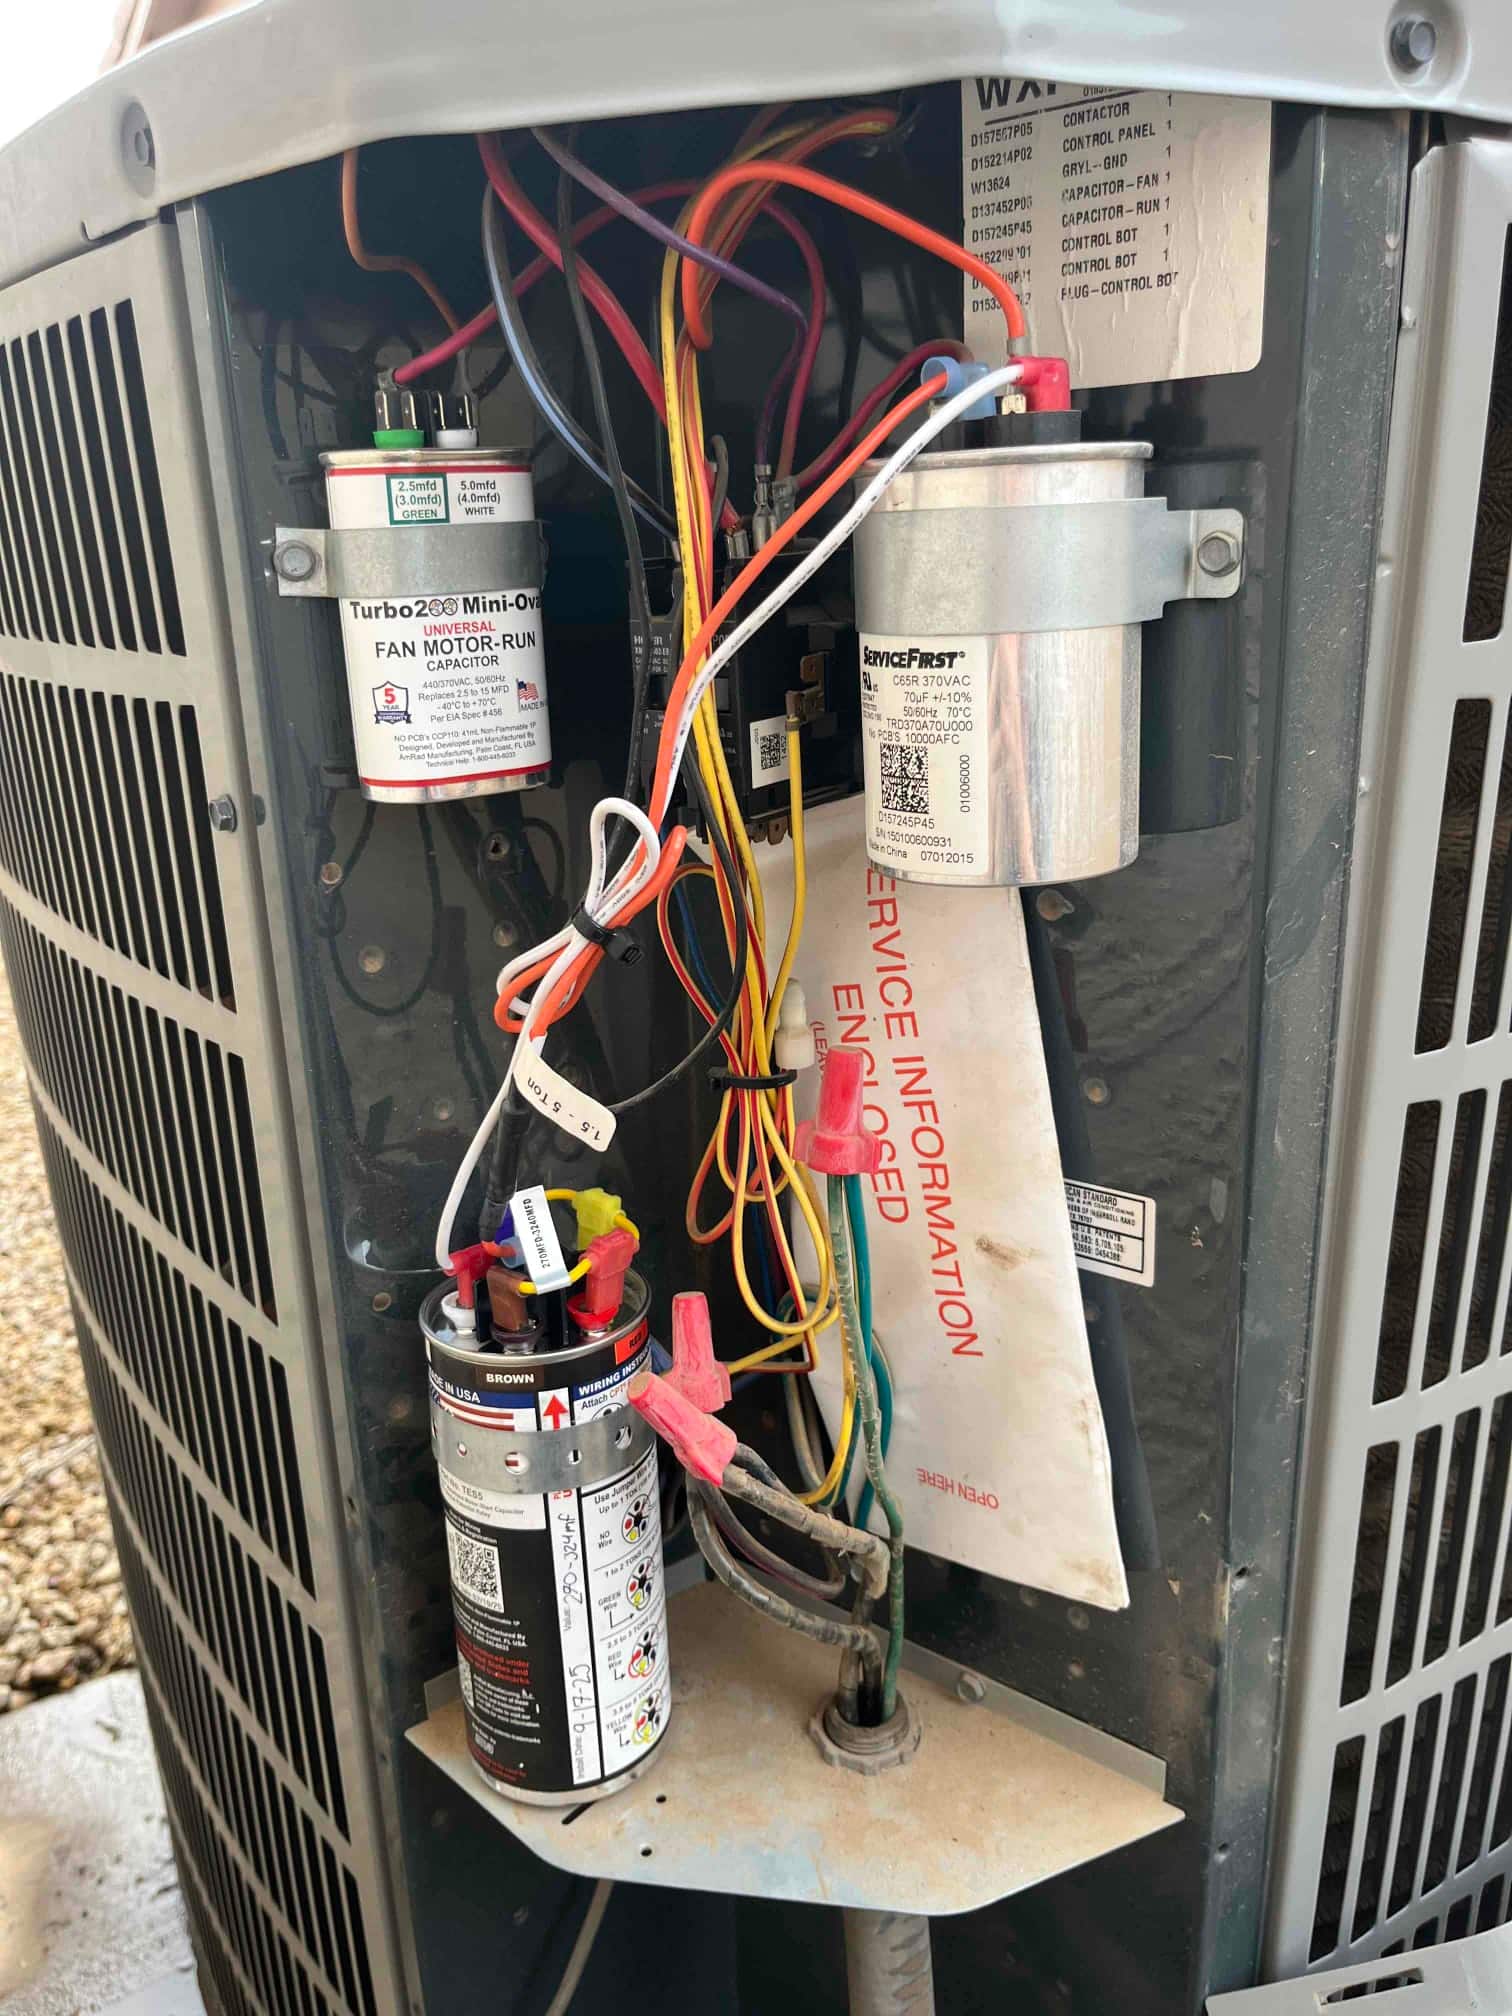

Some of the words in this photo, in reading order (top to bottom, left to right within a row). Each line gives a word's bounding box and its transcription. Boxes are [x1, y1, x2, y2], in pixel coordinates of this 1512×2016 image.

[1063, 102, 1130, 127] CONTACTOR
[1167, 94, 1172, 107] 1
[1063, 131, 1114, 153] CONTROL
[1118, 122, 1156, 144] PANEL
[1167, 120, 1172, 131] 1
[1166, 146, 1172, 158] 1
[1165, 171, 1171, 183] 1
[1165, 197, 1170, 210] 1
[1062, 231, 1112, 253] CONTROL
[1115, 227, 1138, 246] BOT
[1164, 224, 1169, 236] 1
[1061, 256, 1111, 277] CONTROL
[1115, 253, 1137, 271] BOT
[1163, 249, 1168, 261] 1
[398, 480, 437, 492] 2.5mfd
[460, 480, 496, 491] 5.0mfd
[395, 493, 442, 507] (3.0mfd)
[457, 491, 501, 504] (4.0mfd)
[402, 509, 438, 519] GREEN
[464, 507, 495, 516] WHITE
[423, 621, 496, 637] UNIVERSAL
[375, 641, 416, 658] FAN
[423, 631, 536, 657] MOTOR-RUN
[426, 655, 499, 671] CAPACITOR
[893, 675, 919, 687] C65R
[922, 675, 971, 687] 370VAC
[384, 687, 396, 704] 5
[418, 691, 456, 702] Replaces
[470, 688, 480, 697] to
[491, 685, 510, 694] MFD
[932, 691, 972, 703] +/-10%
[462, 700, 471, 708] to
[903, 706, 938, 718] 50/60Hz
[946, 706, 972, 718] 70°C
[430, 713, 445, 723] Per
[461, 711, 481, 722] Spec
[471, 738, 483, 746] and
[484, 734, 526, 744] Manufactured
[960, 754, 970, 813] 01006000
[886, 845, 908, 859] China
[920, 850, 974, 863] 07012015
[866, 868, 919, 1040] ERVICE
[527, 1077, 549, 1106] Ton
[553, 1101, 562, 1114] 5
[580, 1121, 601, 1141] 1.5
[1083, 1190, 1117, 1206] STANDARD
[892, 1055, 984, 1358] INFORMATION
[486, 1373, 535, 1384] BROWN
[578, 1372, 621, 1396] WIRING
[456, 1386, 480, 1404] USA
[582, 1394, 608, 1409] Attach
[915, 1467, 954, 1492] HERE
[594, 1493, 610, 1504] Use
[957, 1483, 999, 1509] OPEN
[599, 1505, 610, 1514] Up
[600, 1530, 610, 1539] NO
[598, 1591, 621, 1606] GREEN
[606, 1711, 632, 1730] YELLOW
